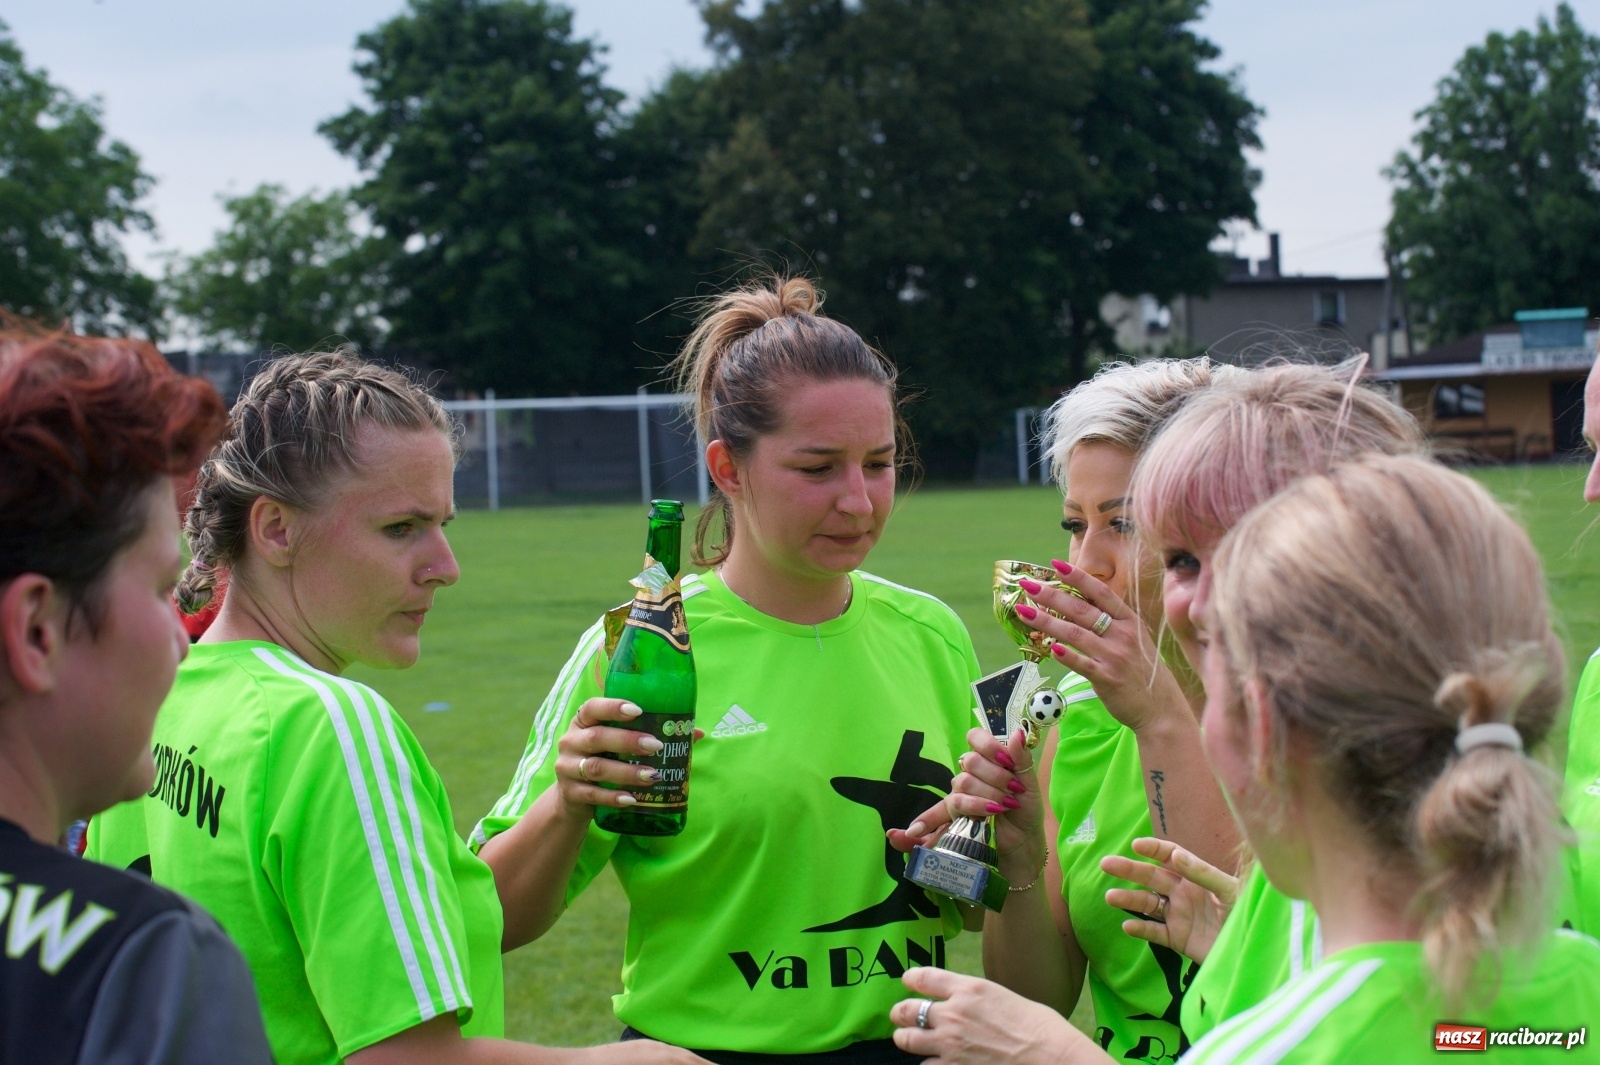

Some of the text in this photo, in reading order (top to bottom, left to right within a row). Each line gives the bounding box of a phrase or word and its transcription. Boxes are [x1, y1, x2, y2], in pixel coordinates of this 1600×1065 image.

[711, 722, 767, 738] adidas
[148, 743, 226, 838] ORKÓW
[940, 865, 975, 879] MAMUSIEK
[728, 950, 808, 991] Va
